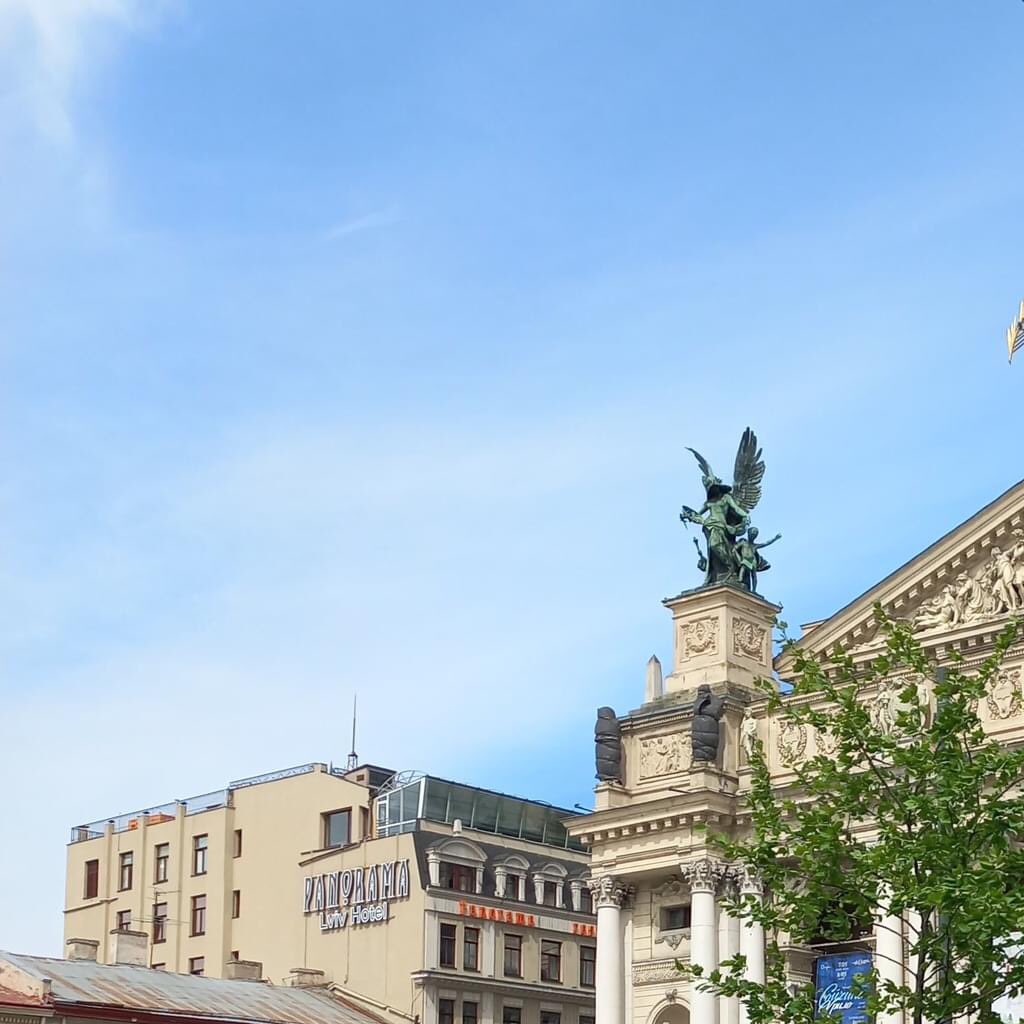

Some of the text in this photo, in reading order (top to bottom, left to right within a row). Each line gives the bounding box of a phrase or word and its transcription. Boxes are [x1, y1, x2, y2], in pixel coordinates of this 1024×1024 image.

[303, 859, 410, 913] PANORAMA
[320, 902, 388, 930] Lviv Hotel
